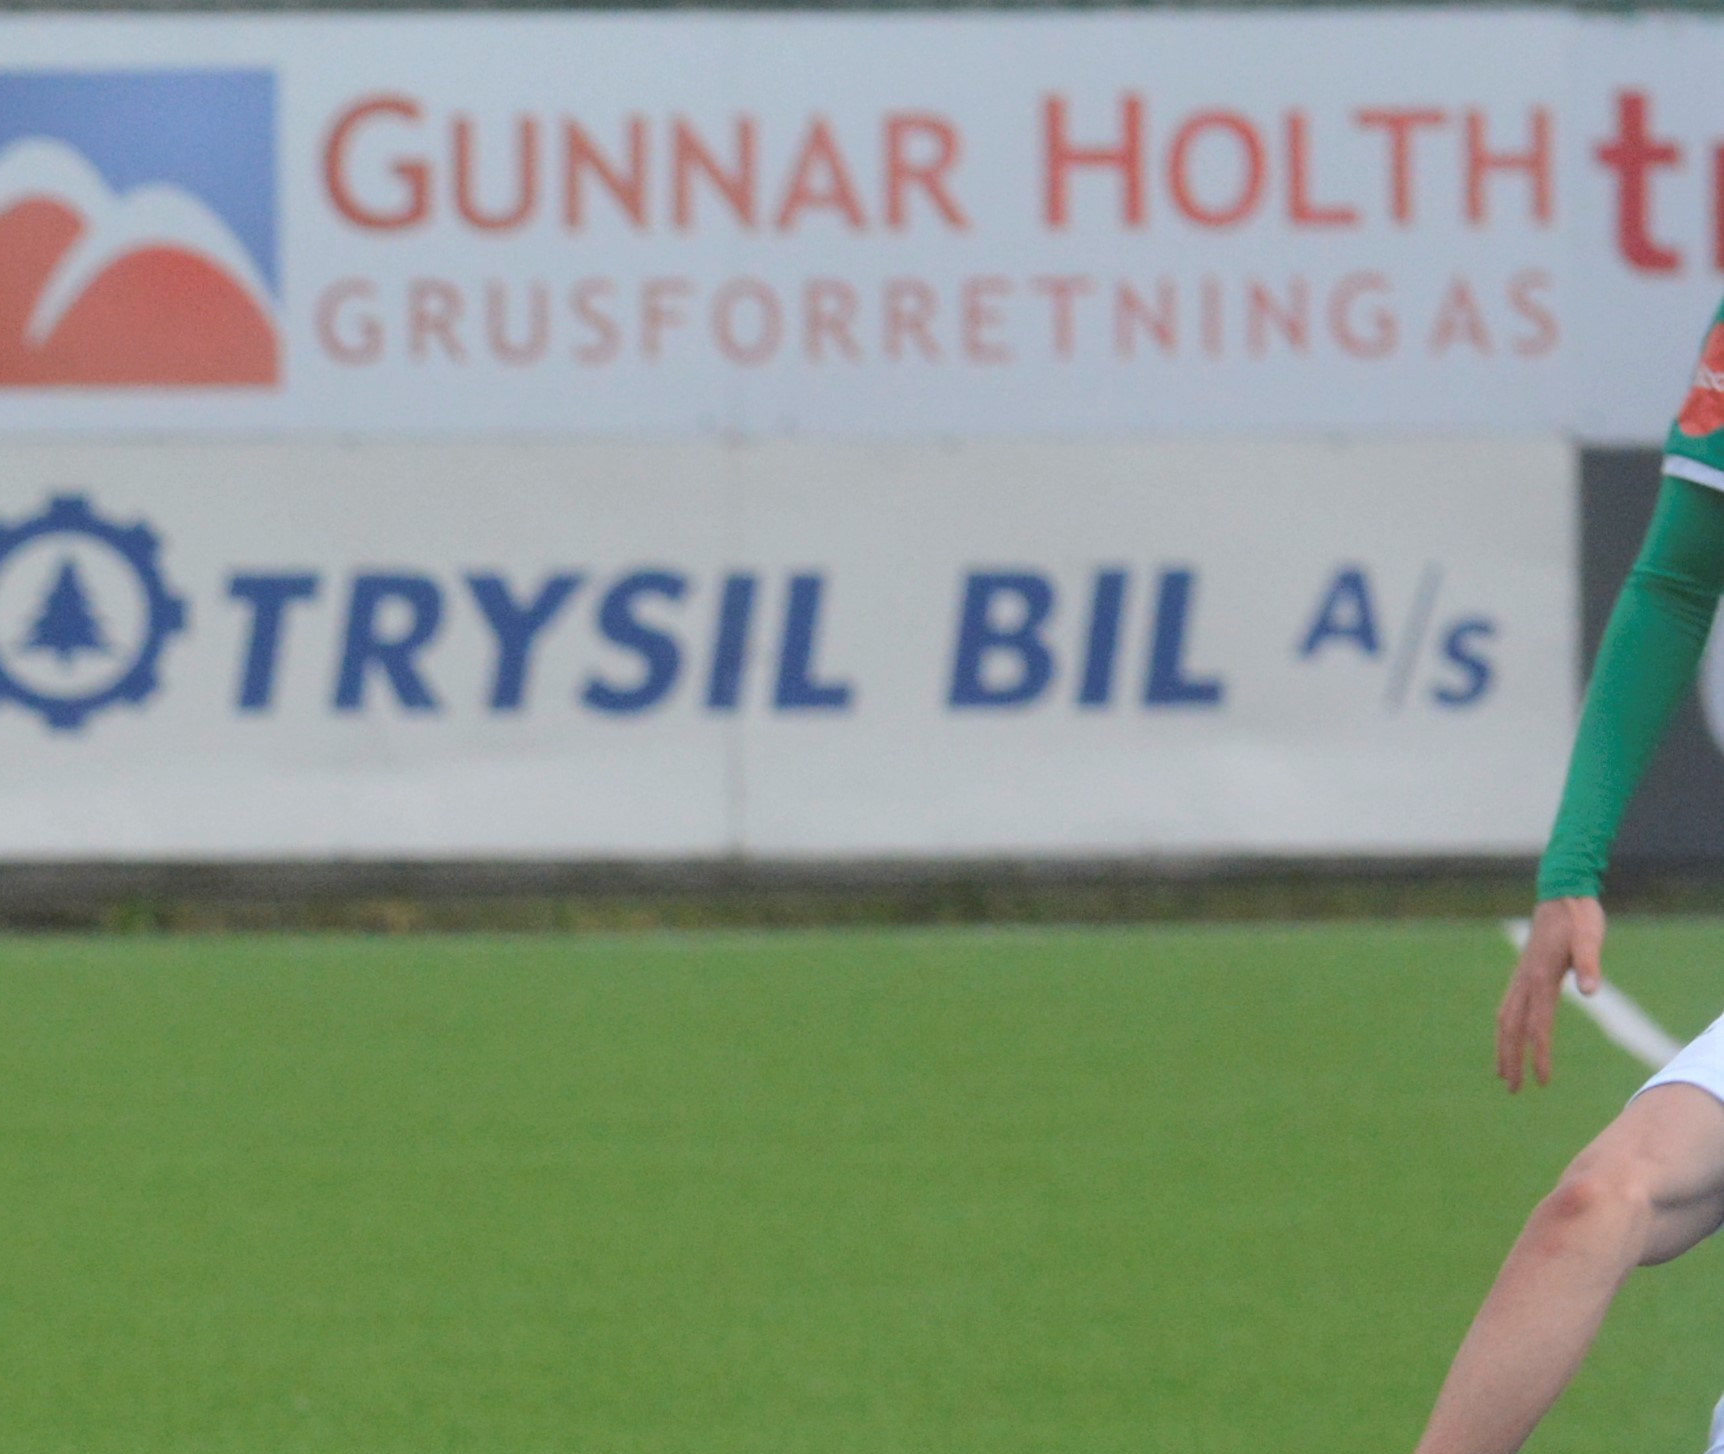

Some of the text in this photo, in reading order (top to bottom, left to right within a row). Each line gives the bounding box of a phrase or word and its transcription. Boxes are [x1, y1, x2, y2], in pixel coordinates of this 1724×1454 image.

[320, 90, 1556, 234] GUNNAR HOLTH
[224, 564, 856, 717] TRYSIL
[945, 565, 1226, 713] BIL
